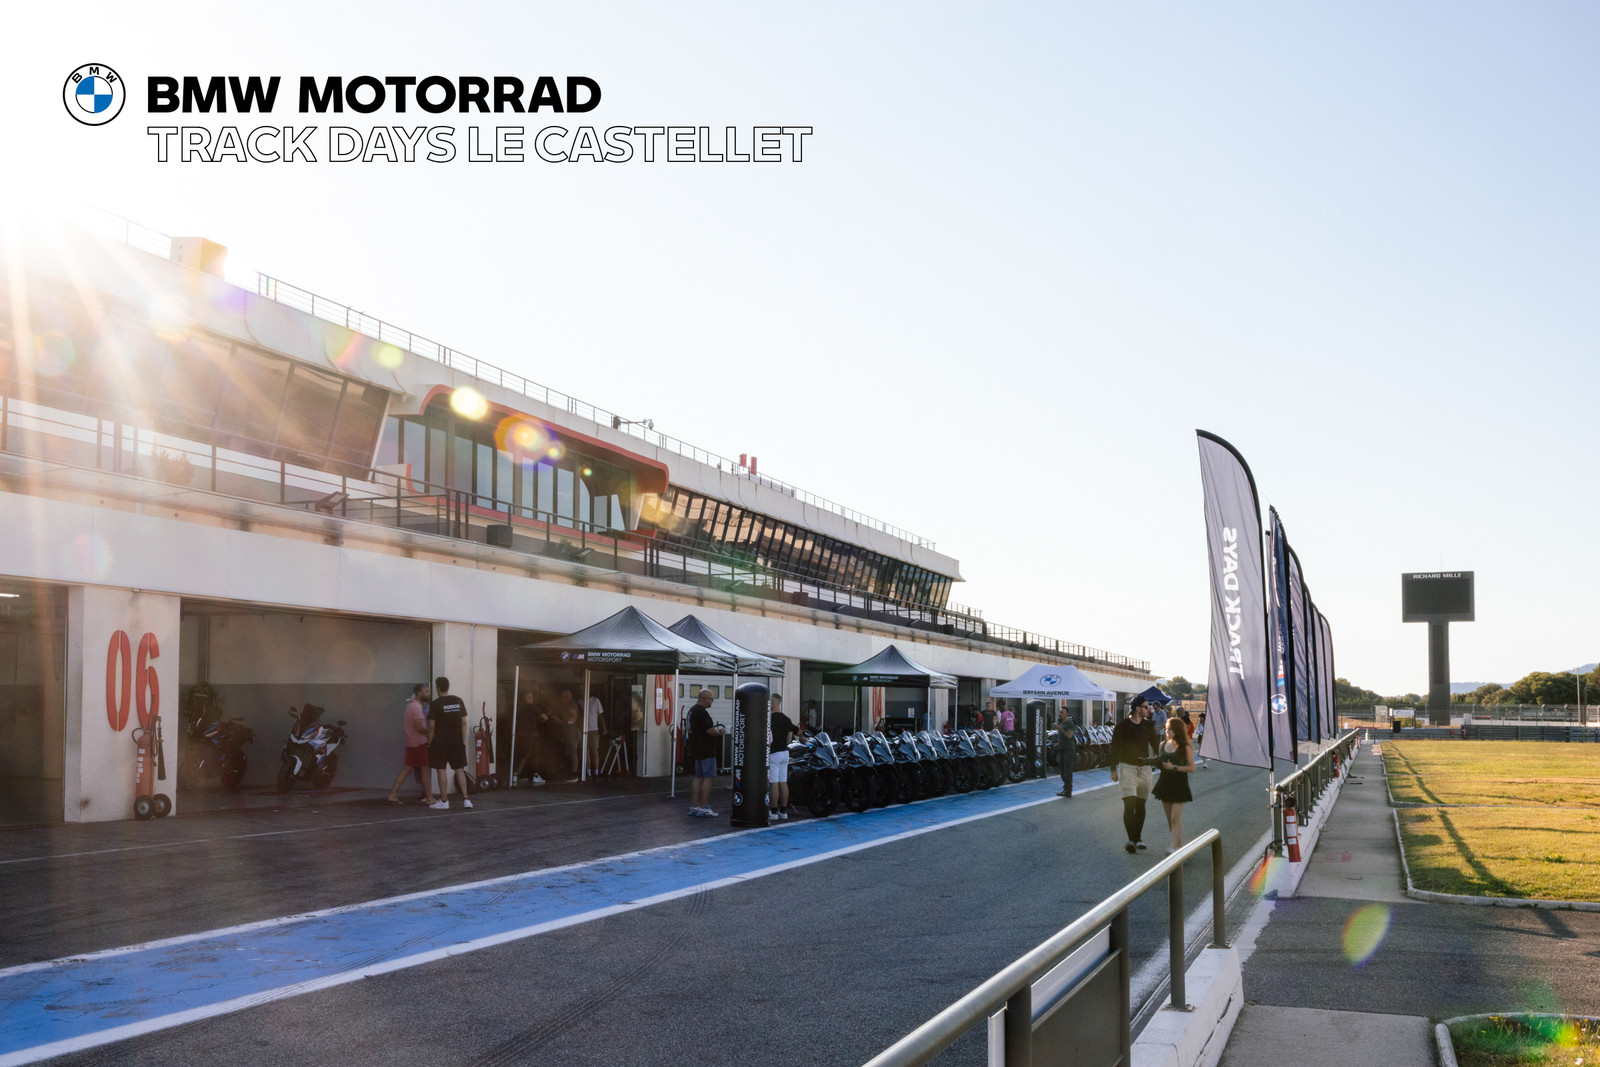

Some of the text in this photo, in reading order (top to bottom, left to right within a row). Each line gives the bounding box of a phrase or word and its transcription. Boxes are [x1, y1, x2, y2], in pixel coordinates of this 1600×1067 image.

[106, 629, 160, 732] 06
[655, 674, 673, 726] 05
[738, 713, 746, 767] MOTORSPORT
